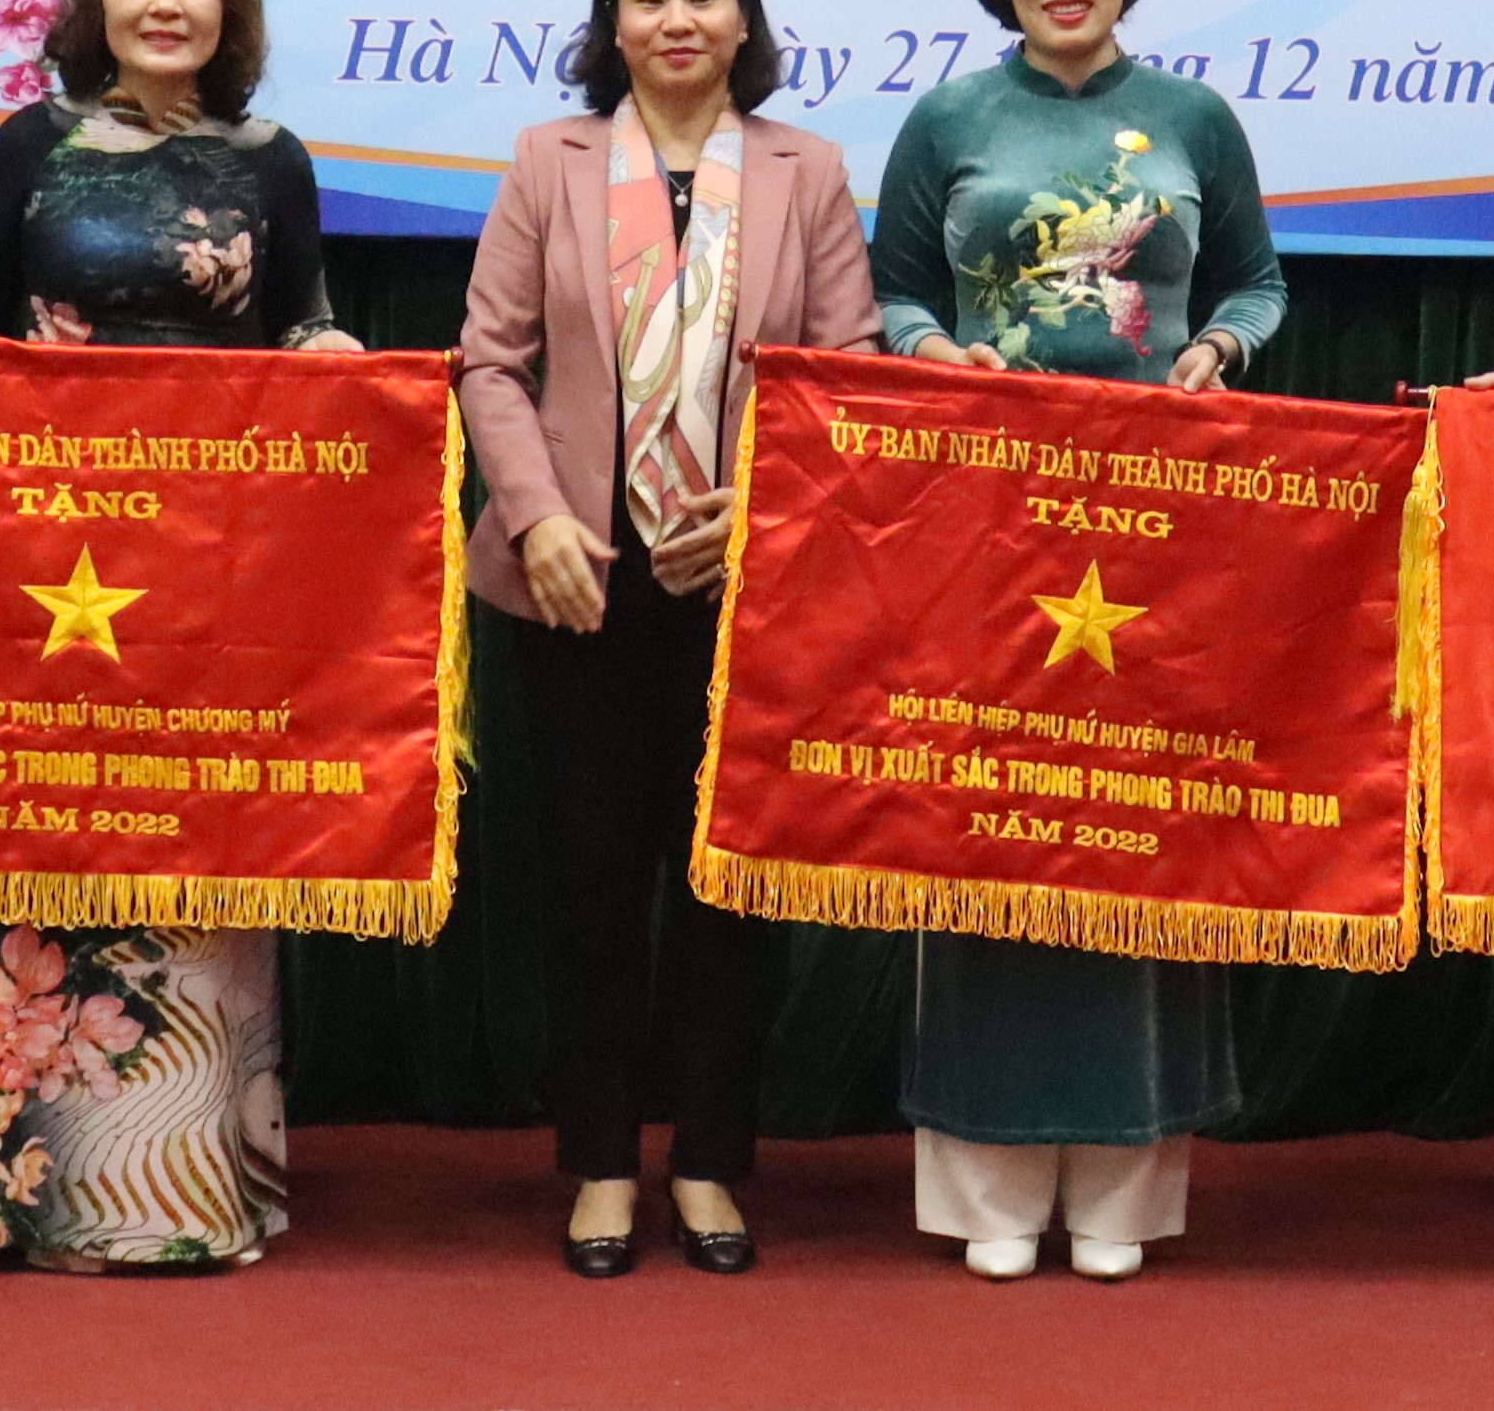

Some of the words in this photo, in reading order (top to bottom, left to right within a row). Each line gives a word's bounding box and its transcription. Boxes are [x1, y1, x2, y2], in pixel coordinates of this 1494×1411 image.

[337, 18, 454, 83] Hà
[876, 30, 968, 92] 27
[1237, 38, 1319, 101] 12
[19, 426, 83, 469] DÂN
[88, 429, 193, 470] THÀNH
[198, 426, 260, 472] PHỐ
[265, 432, 307, 472] HÀ
[315, 433, 368, 480] NỘI
[828, 407, 872, 455] ỦY
[879, 426, 941, 461] BAN
[948, 427, 1032, 471] NHÂN
[1037, 439, 1101, 481] DÂN
[1108, 449, 1208, 494] THÀNH
[1213, 456, 1276, 501] PHỐ
[1279, 465, 1319, 507] HÀ
[1327, 473, 1380, 519] NỘI
[11, 483, 162, 523] TẶNG
[1027, 497, 1173, 538] TẶNG
[93, 701, 162, 737] HUYỆN
[167, 708, 253, 732] CHƯƠNG
[889, 690, 926, 726] HỘI
[929, 691, 973, 725] LIÊN
[1100, 716, 1169, 759] HUYỆN
[1173, 733, 1207, 755] GIA
[1213, 728, 1255, 762] LÂM
[13, 751, 97, 786] TRONG
[105, 754, 191, 790] PHONG
[267, 760, 310, 792] THI
[308, 761, 364, 794] ĐUA
[1007, 760, 1083, 798] TRONG
[1090, 769, 1172, 810] PHONG
[1249, 788, 1285, 822] THI
[1290, 793, 1340, 827] ĐUA
[91, 811, 179, 836] 2022
[970, 811, 1064, 843] NĂM
[1074, 825, 1158, 855] 2022
